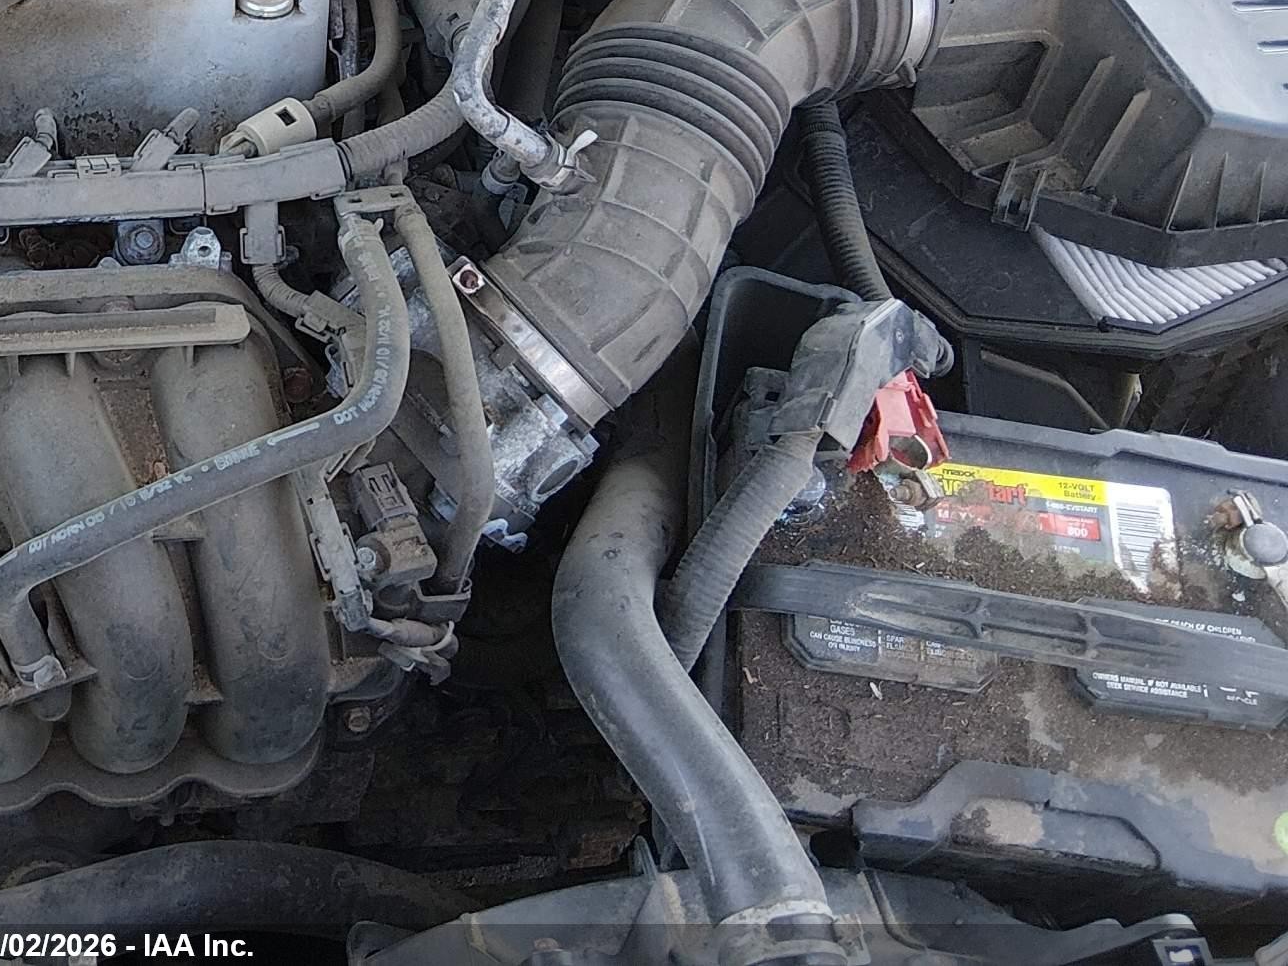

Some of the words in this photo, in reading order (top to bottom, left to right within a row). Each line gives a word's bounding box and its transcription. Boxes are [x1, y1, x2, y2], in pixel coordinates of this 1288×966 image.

[333, 405, 358, 426] DOT
[941, 468, 976, 479] maxx
[1058, 482, 1096, 493] 12-VOLT
[1063, 491, 1097, 502] Battery
[28, 536, 49, 555] DOT
[829, 624, 856, 637] GASES
